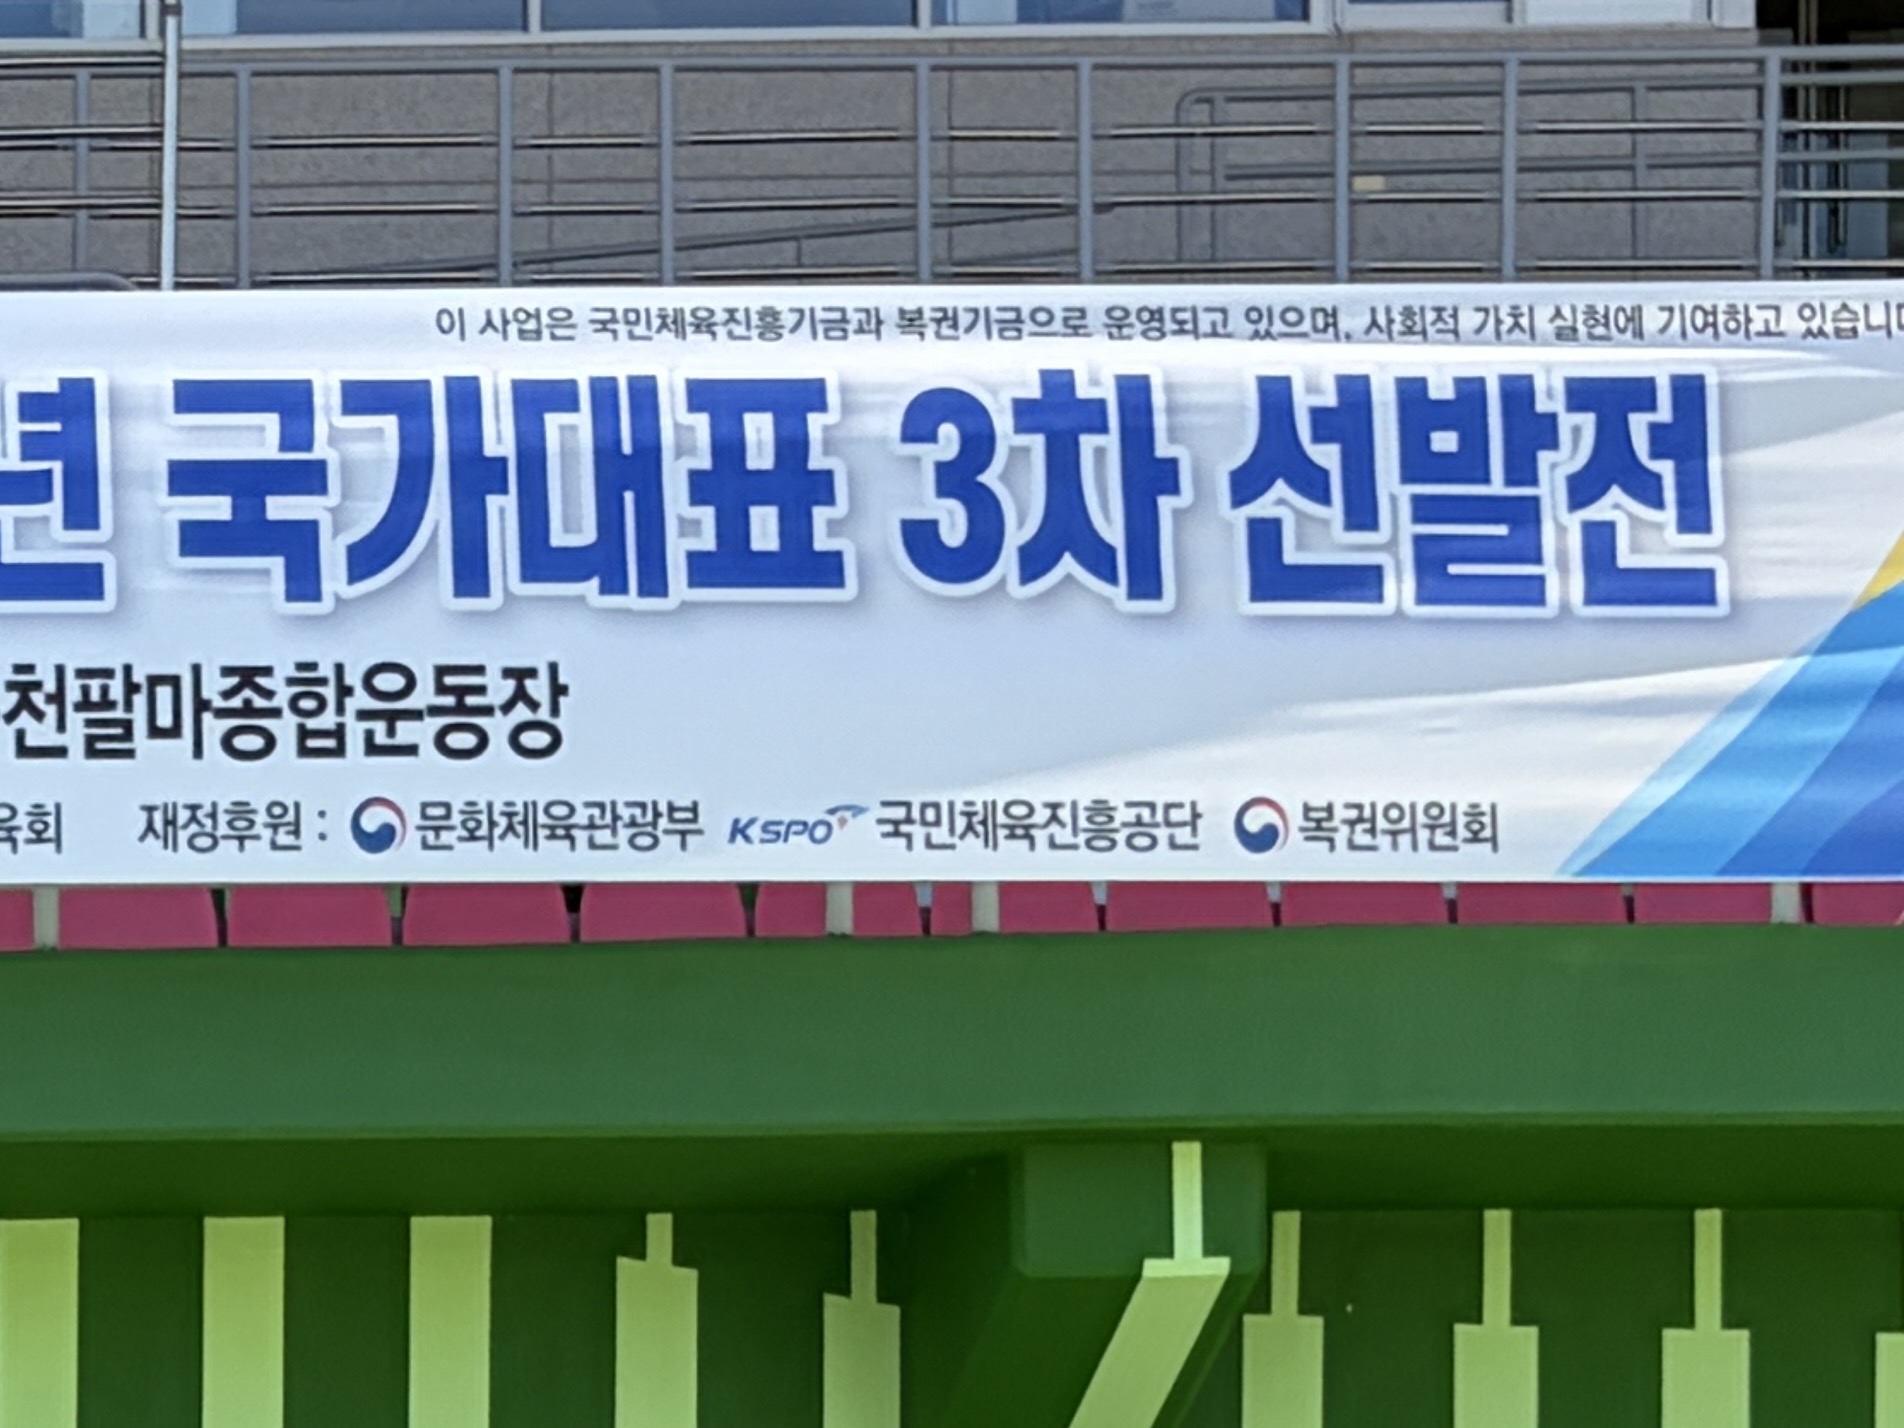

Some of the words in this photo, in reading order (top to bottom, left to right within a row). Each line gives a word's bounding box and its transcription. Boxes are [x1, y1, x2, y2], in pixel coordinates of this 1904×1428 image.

[435, 307, 466, 342] 이
[478, 307, 578, 342] 사업은
[588, 306, 886, 342] 국민체육진흥기금과
[895, 305, 1093, 341] 복권기금으로
[1102, 305, 1235, 341] 운영되고
[1244, 305, 1353, 342] 있으며,
[1363, 305, 1461, 343] 사회적
[1473, 304, 1537, 343] 가치
[1548, 304, 1645, 343] 실현에
[1657, 303, 1787, 342] 기여하고
[167, 375, 846, 603] 국가대표
[899, 369, 1181, 601] 3차
[1228, 373, 1718, 607] 선발전
[138, 800, 302, 854] 재정후원
[415, 799, 705, 852] 문화체육관광부
[726, 815, 833, 846] KSPO
[875, 799, 1203, 853] 국민체육진흥공단
[1298, 801, 1499, 854] 복권위원회
